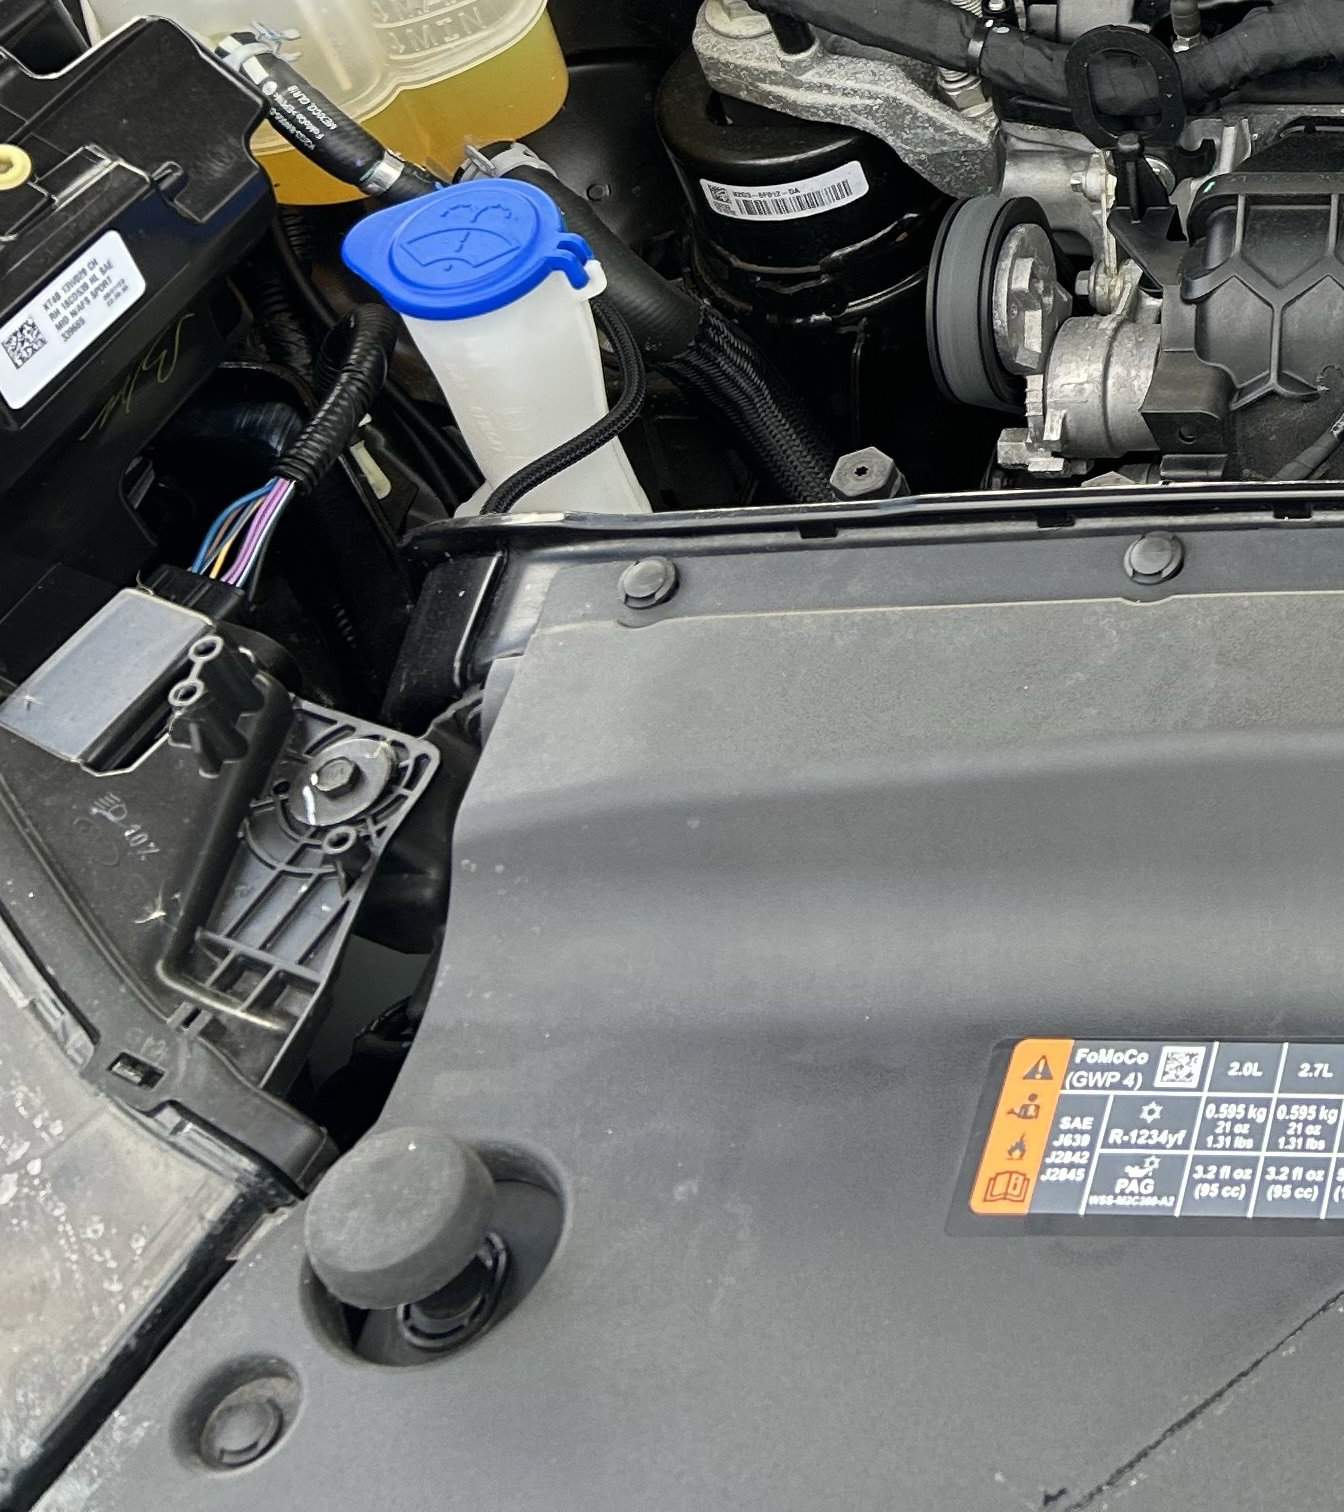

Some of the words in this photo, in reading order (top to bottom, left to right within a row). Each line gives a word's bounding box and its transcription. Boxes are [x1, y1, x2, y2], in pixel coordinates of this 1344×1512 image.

[406, 7, 487, 52] MIN
[1075, 1048, 1149, 1065] FoMoCo
[1227, 1061, 1263, 1077] 2.0L
[1298, 1063, 1334, 1078] 2.7L
[1064, 1070, 1121, 1090] (GWP
[1122, 1071, 1143, 1091] 4)
[1205, 1103, 1246, 1119] 0.595
[1247, 1105, 1268, 1123] kg
[1276, 1105, 1317, 1121] 0.595
[1319, 1106, 1339, 1124] kg
[1059, 1116, 1094, 1130] SAE
[1214, 1121, 1231, 1134] 21
[1233, 1124, 1250, 1134] oz
[1286, 1122, 1303, 1135] 21
[1305, 1125, 1322, 1136] oz
[1052, 1134, 1091, 1148] J639
[1108, 1128, 1187, 1149] R-1234yf
[1206, 1135, 1231, 1149] 1.31
[1233, 1136, 1254, 1149] lbs
[1278, 1137, 1303, 1150] 1.31
[1305, 1137, 1325, 1151] lbs
[1192, 1165, 1217, 1179] 3.2
[1219, 1165, 1231, 1179] fl
[1232, 1168, 1253, 1180] oz
[1265, 1166, 1289, 1181] 3.2
[1291, 1166, 1304, 1181] fl
[1305, 1169, 1325, 1182] oz
[1114, 1179, 1155, 1195] PAG
[1194, 1184, 1219, 1200] (95
[1221, 1184, 1246, 1201] cc)
[1267, 1185, 1292, 1201] (95
[1294, 1185, 1319, 1202] cc)
